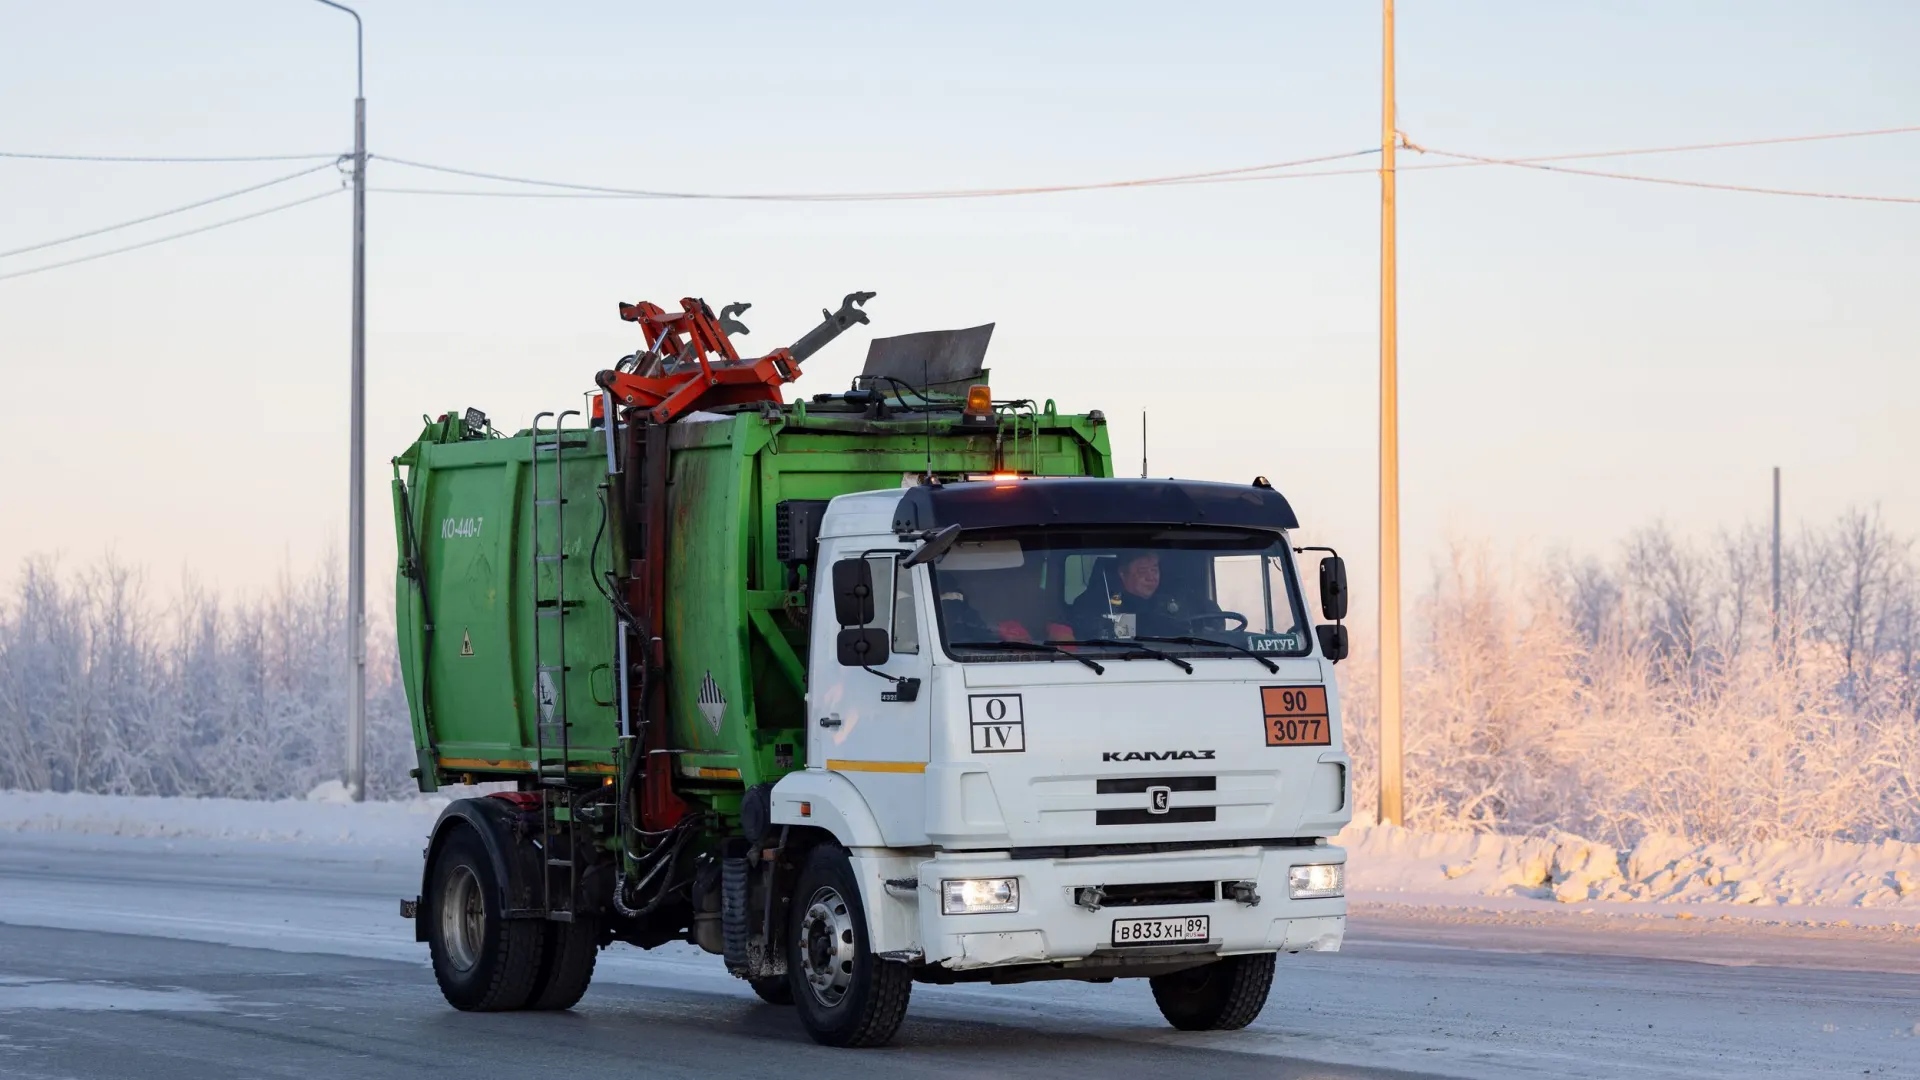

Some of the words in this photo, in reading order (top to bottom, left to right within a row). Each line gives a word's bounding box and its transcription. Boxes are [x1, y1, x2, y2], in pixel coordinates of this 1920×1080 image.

[441, 516, 483, 539] КО-440-7
[1257, 638, 1295, 651] АРТУР
[1282, 690, 1307, 711] 90
[982, 726, 1012, 748] IV
[1273, 719, 1321, 741] 3077
[1102, 749, 1216, 762] КАМАЗ
[1121, 921, 1183, 940] В833ХН
[1187, 919, 1202, 932] 89
